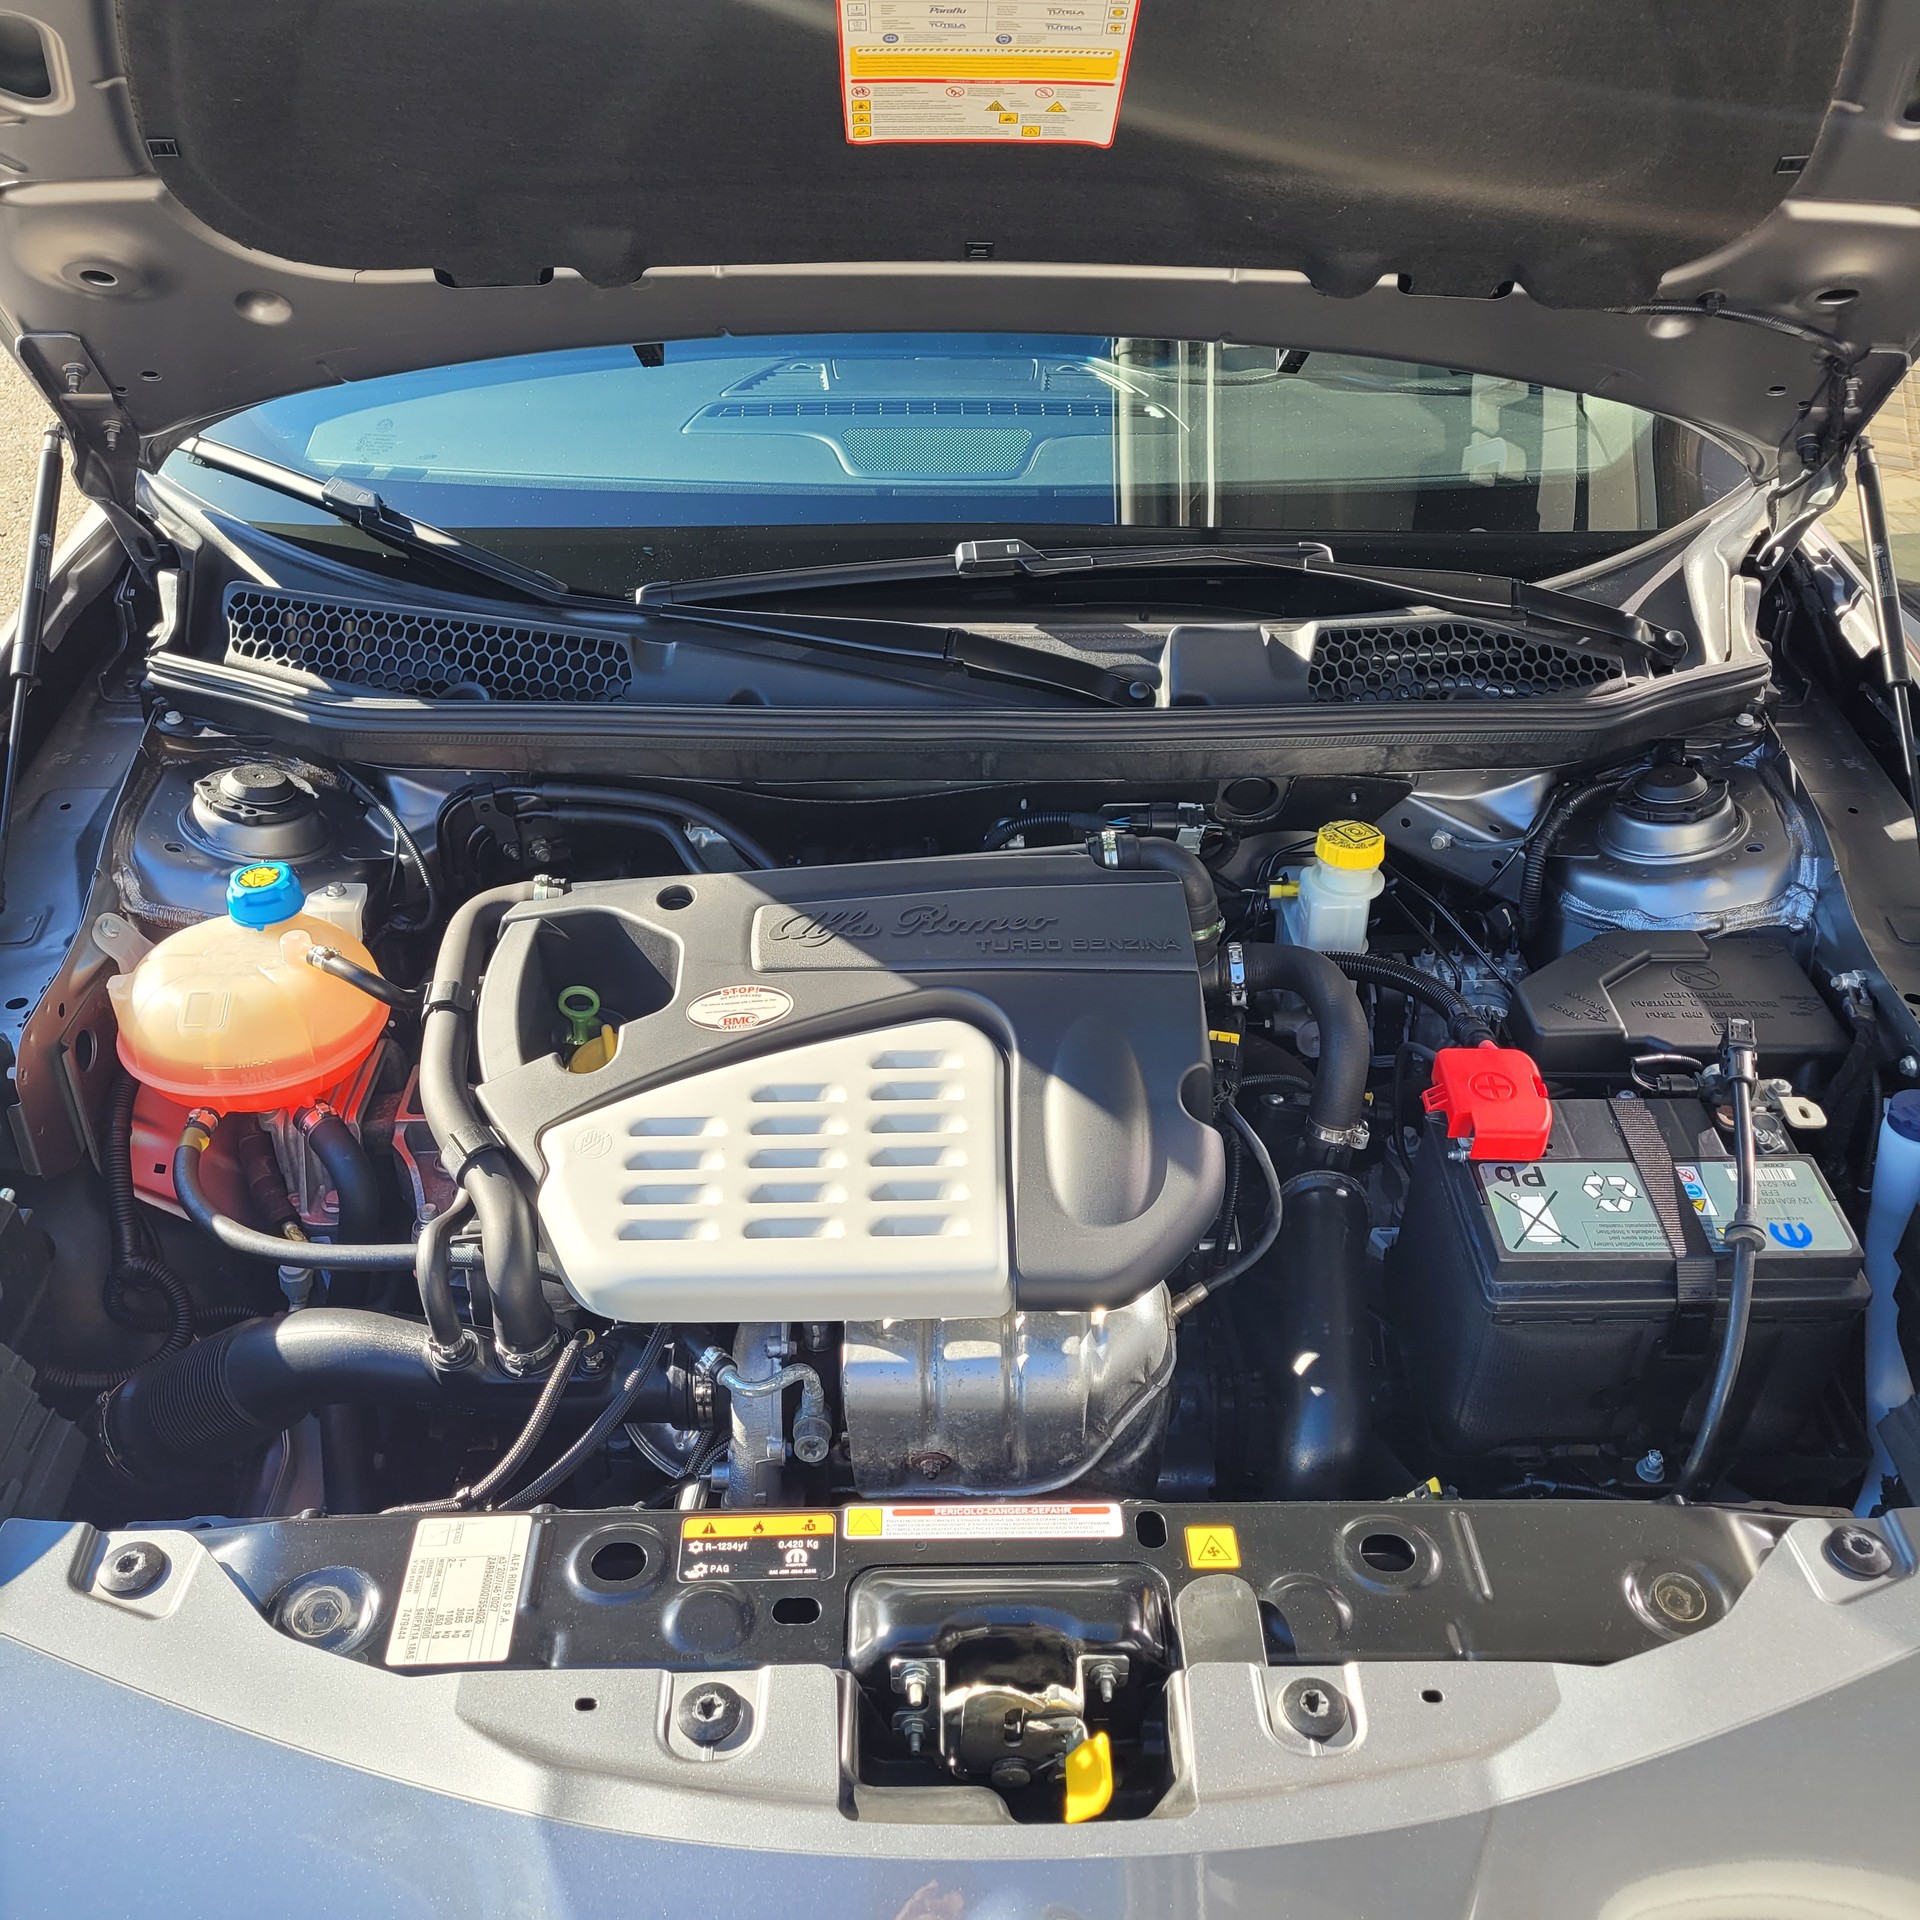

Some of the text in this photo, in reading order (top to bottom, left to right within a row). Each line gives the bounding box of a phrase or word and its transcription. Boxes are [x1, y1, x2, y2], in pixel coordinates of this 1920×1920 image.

[768, 903, 1059, 948] Alfa Romeo
[975, 936, 1181, 951] TURBO BENZINA
[1548, 1003, 1584, 1021] SCREW
[723, 1016, 754, 1026] BMC
[1495, 1166, 1547, 1187] Pb
[933, 1506, 1072, 1516] PERICOLO-DANGER-GEFAHR
[705, 1539, 819, 1551] R-1234yf 0.420 Kg
[710, 1564, 729, 1573] PAG
[499, 1553, 520, 1626] ALFA ROMEO S.P.A.
[434, 1614, 444, 1625] 850
[444, 1610, 454, 1625] 1100
[451, 1607, 465, 1638] 3085 kg
[461, 1608, 474, 1638] 1785 kg
[431, 1630, 441, 1639] kg
[441, 1630, 451, 1639] kg
[405, 1642, 416, 1659] 18AS
